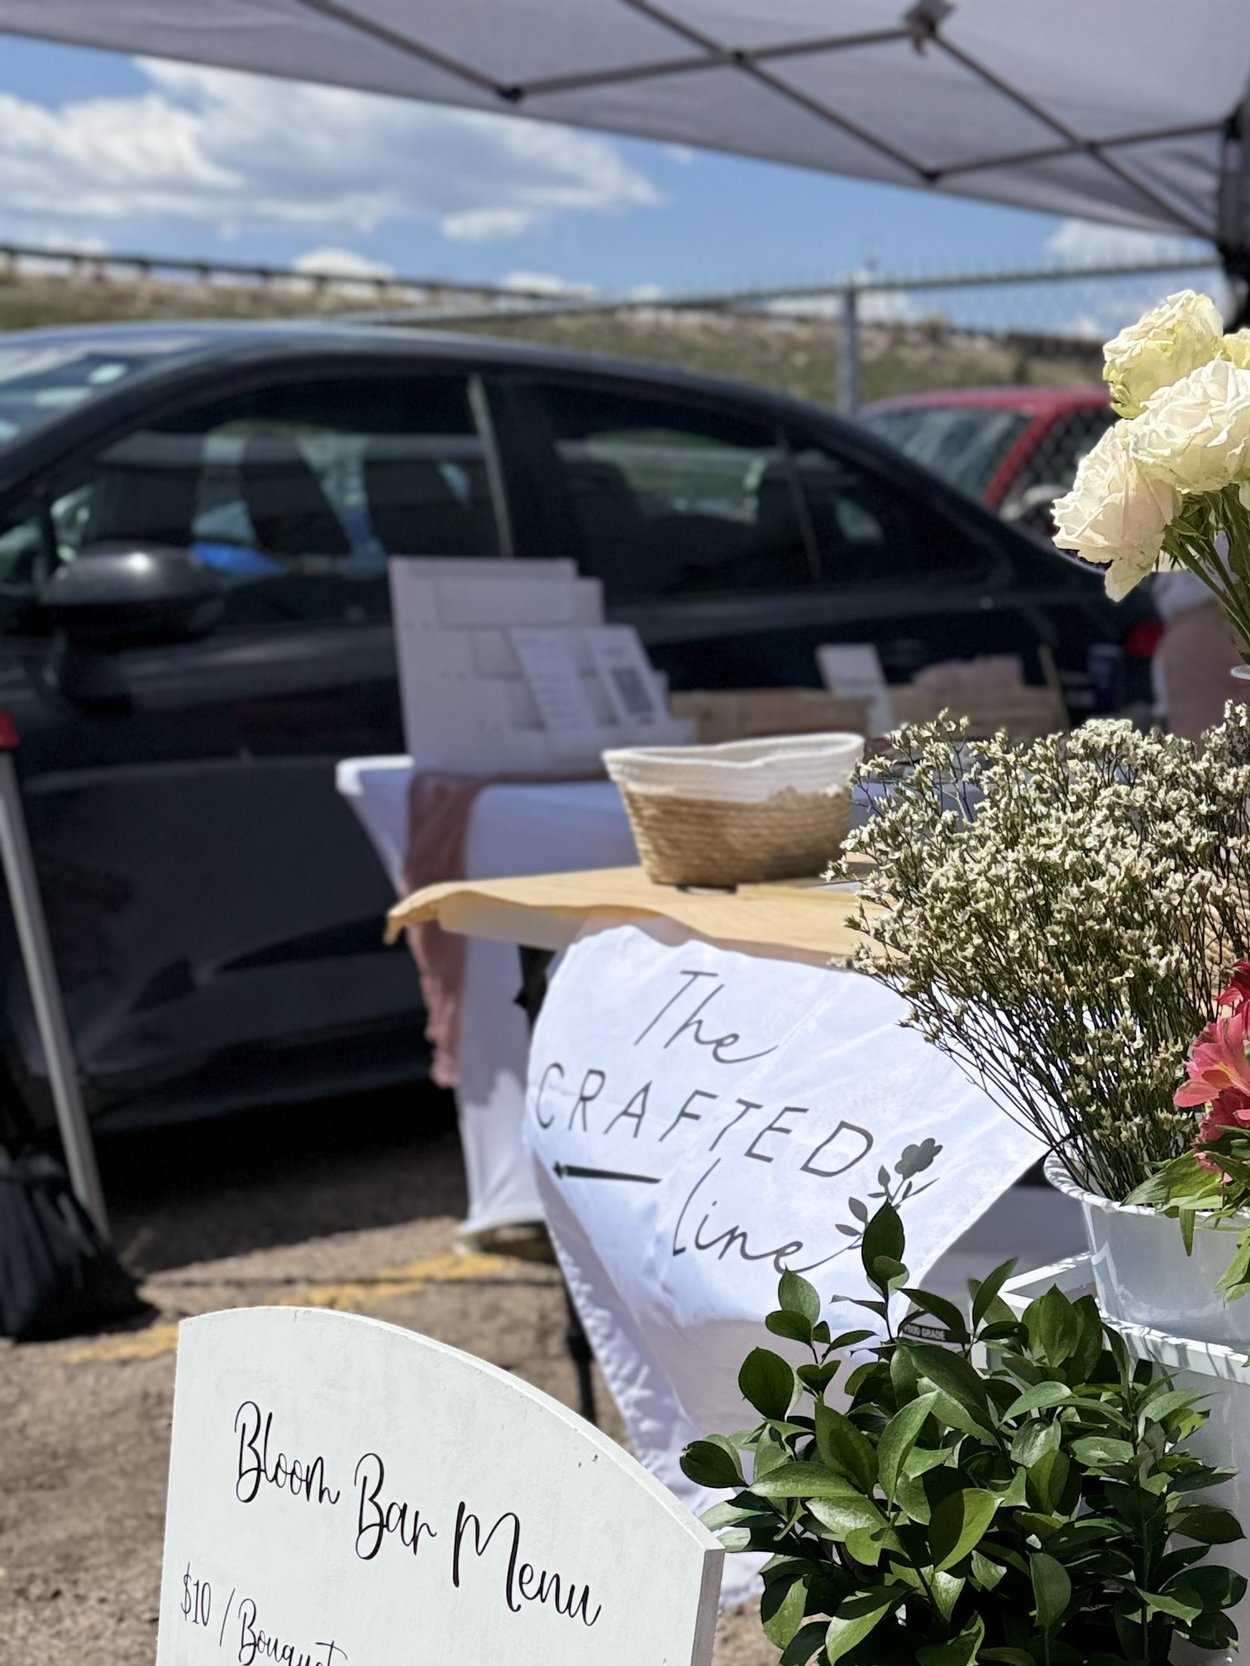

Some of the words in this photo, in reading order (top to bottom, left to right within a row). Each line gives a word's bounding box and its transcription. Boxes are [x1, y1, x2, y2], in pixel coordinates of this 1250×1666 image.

[635, 969, 778, 1065] The
[534, 1062, 875, 1179] CRAFTED
[235, 1400, 341, 1505] Bloom
[354, 1452, 438, 1560] Bar
[452, 1501, 602, 1627] Menu
[180, 1561, 212, 1627] $10
